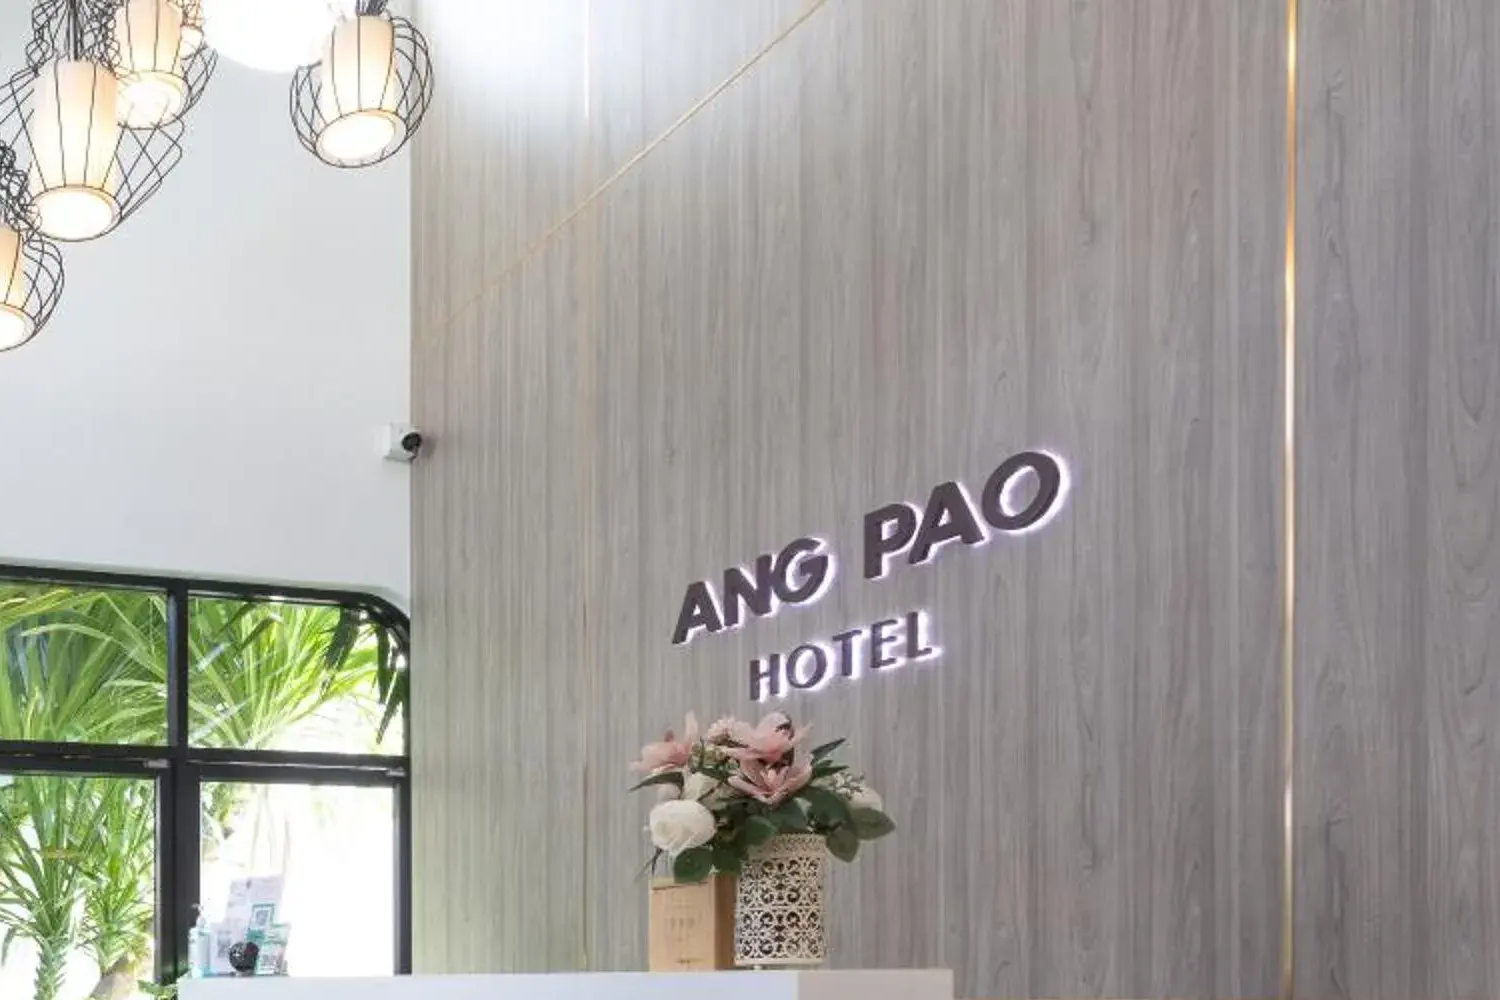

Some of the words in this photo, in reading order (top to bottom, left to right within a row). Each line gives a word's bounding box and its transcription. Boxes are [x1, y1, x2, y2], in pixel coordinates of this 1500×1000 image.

[672, 538, 830, 645] ANG
[864, 451, 1064, 580] PAO
[750, 612, 936, 701] HOTEL
